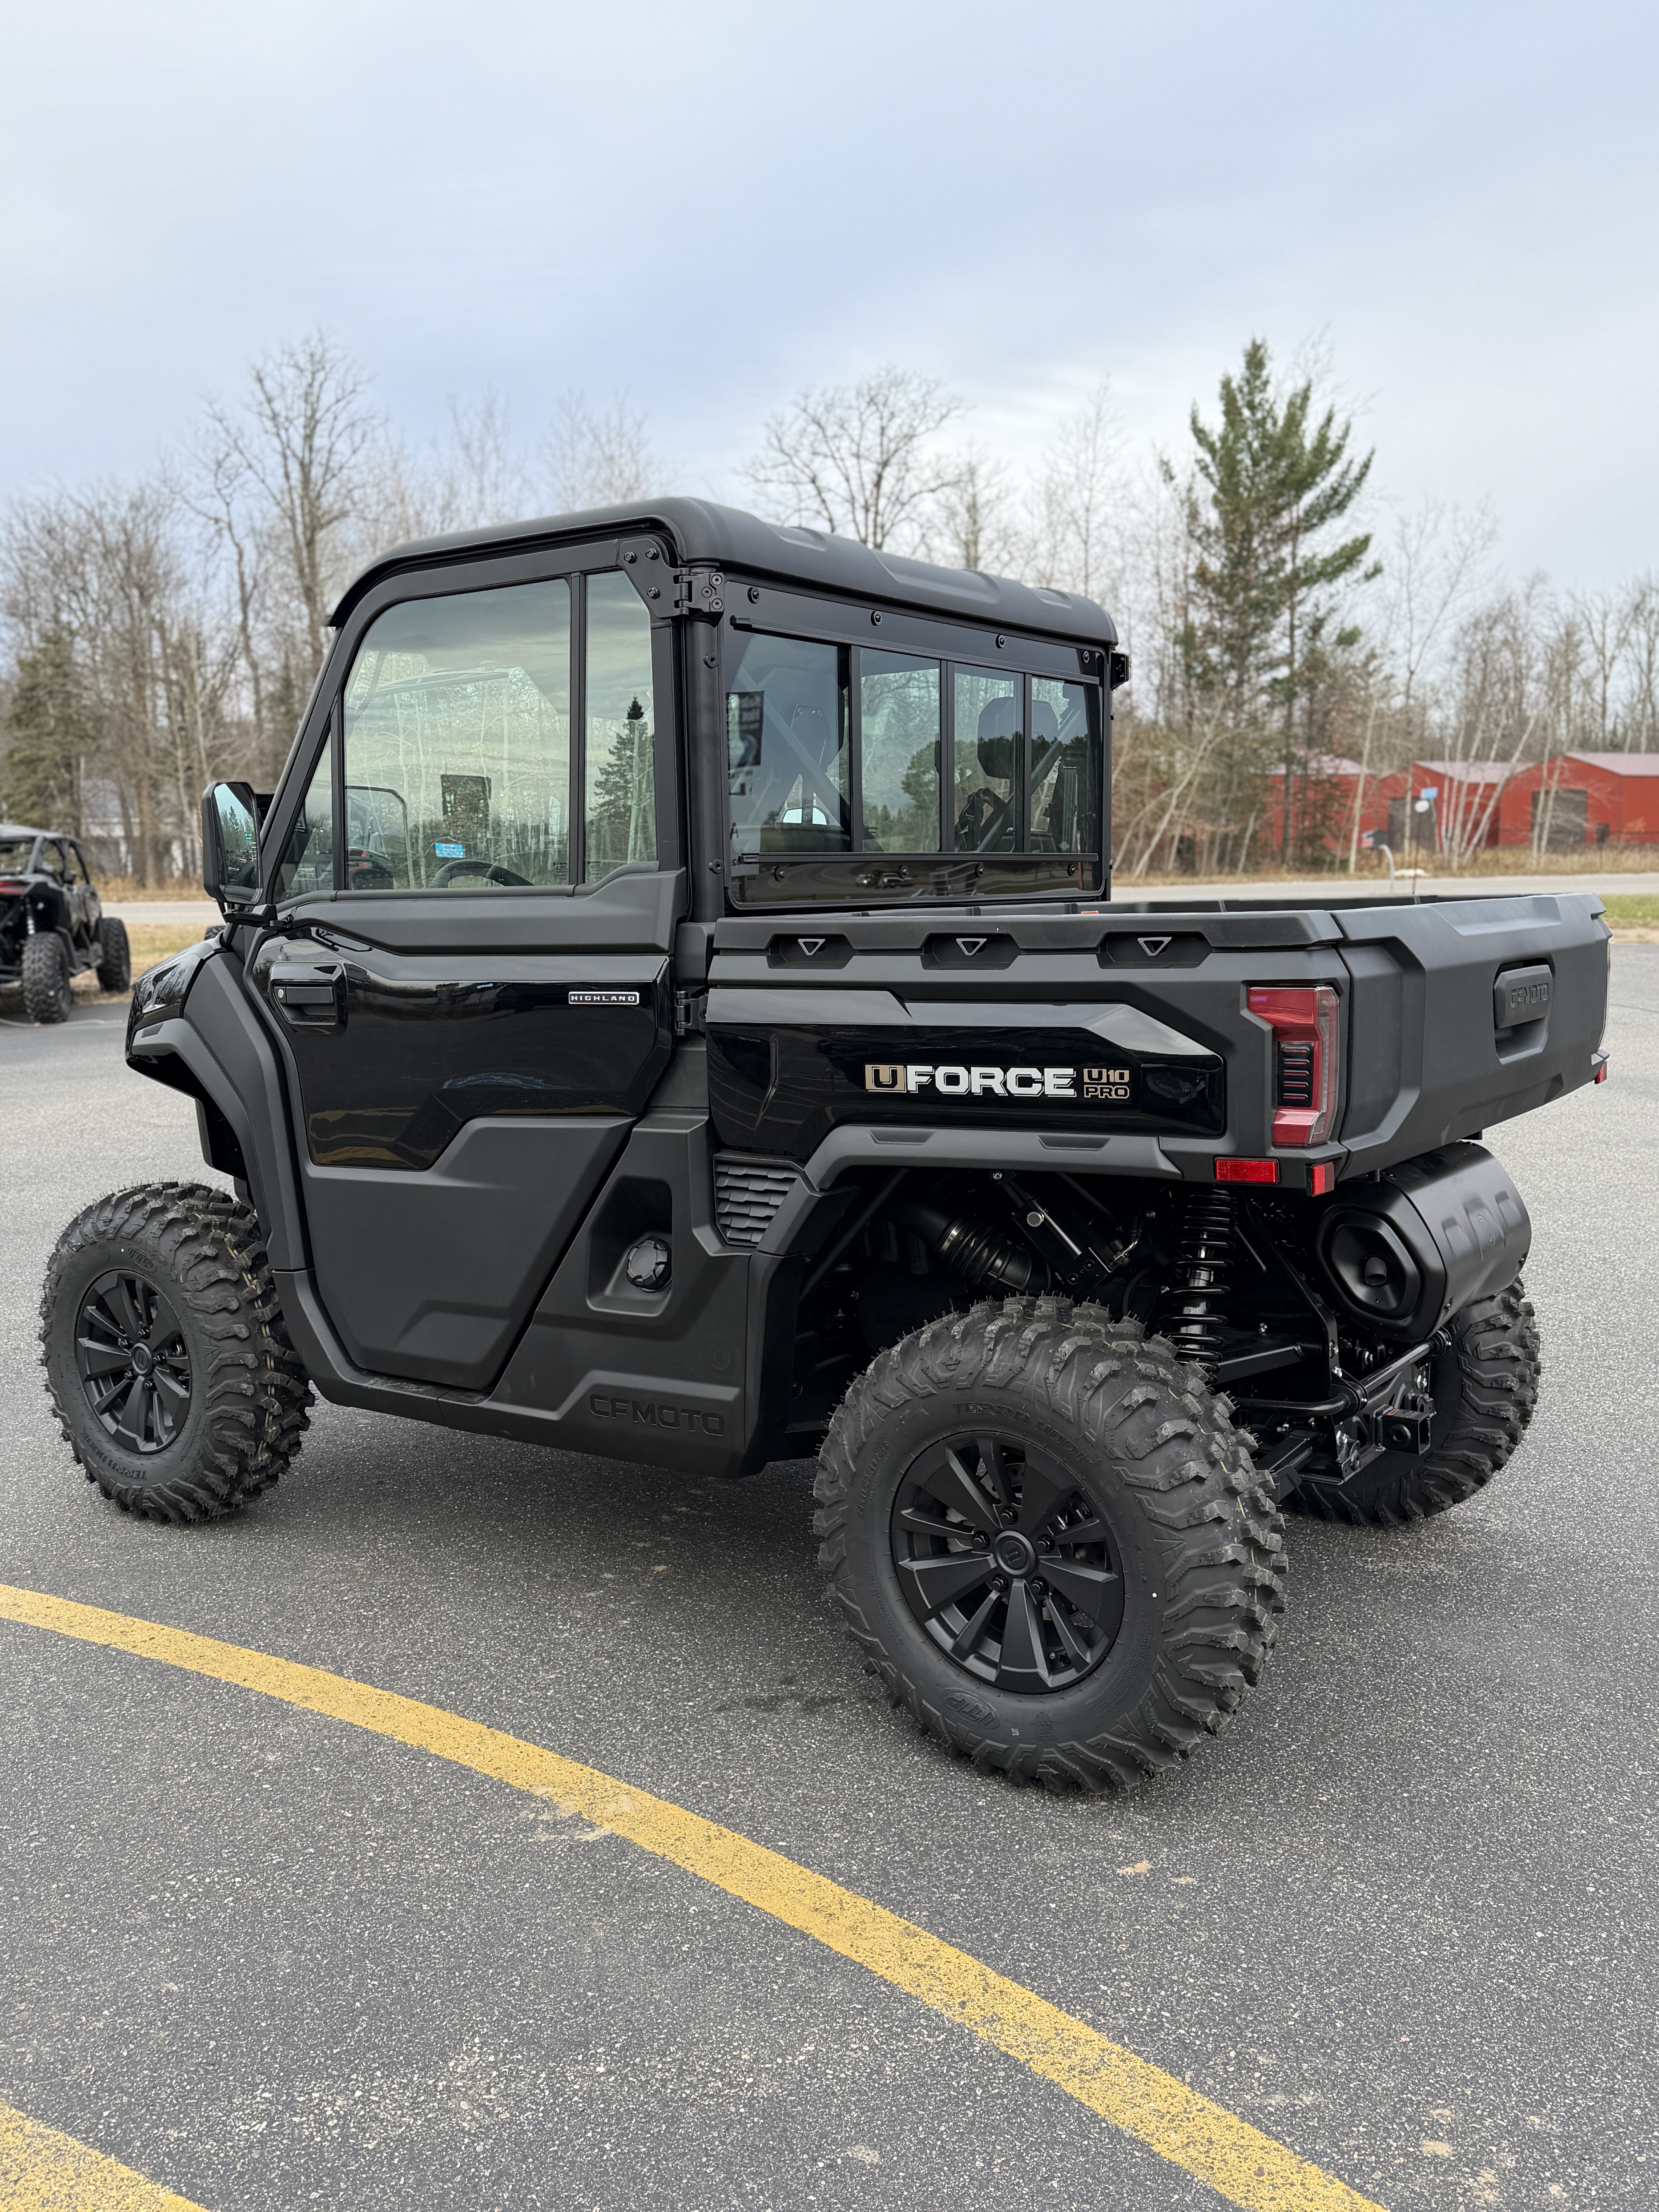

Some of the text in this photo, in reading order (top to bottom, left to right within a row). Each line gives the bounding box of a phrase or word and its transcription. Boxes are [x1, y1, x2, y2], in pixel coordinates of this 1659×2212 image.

[1084, 1068, 1130, 1083] U10
[1084, 1085, 1130, 1099] PRO
[590, 1394, 725, 1436] CFMOTO
[951, 1401, 1094, 1464] TERRA HOOK
[80, 1425, 148, 1479] TERRA HOOK
[946, 1697, 996, 1726] ITP
